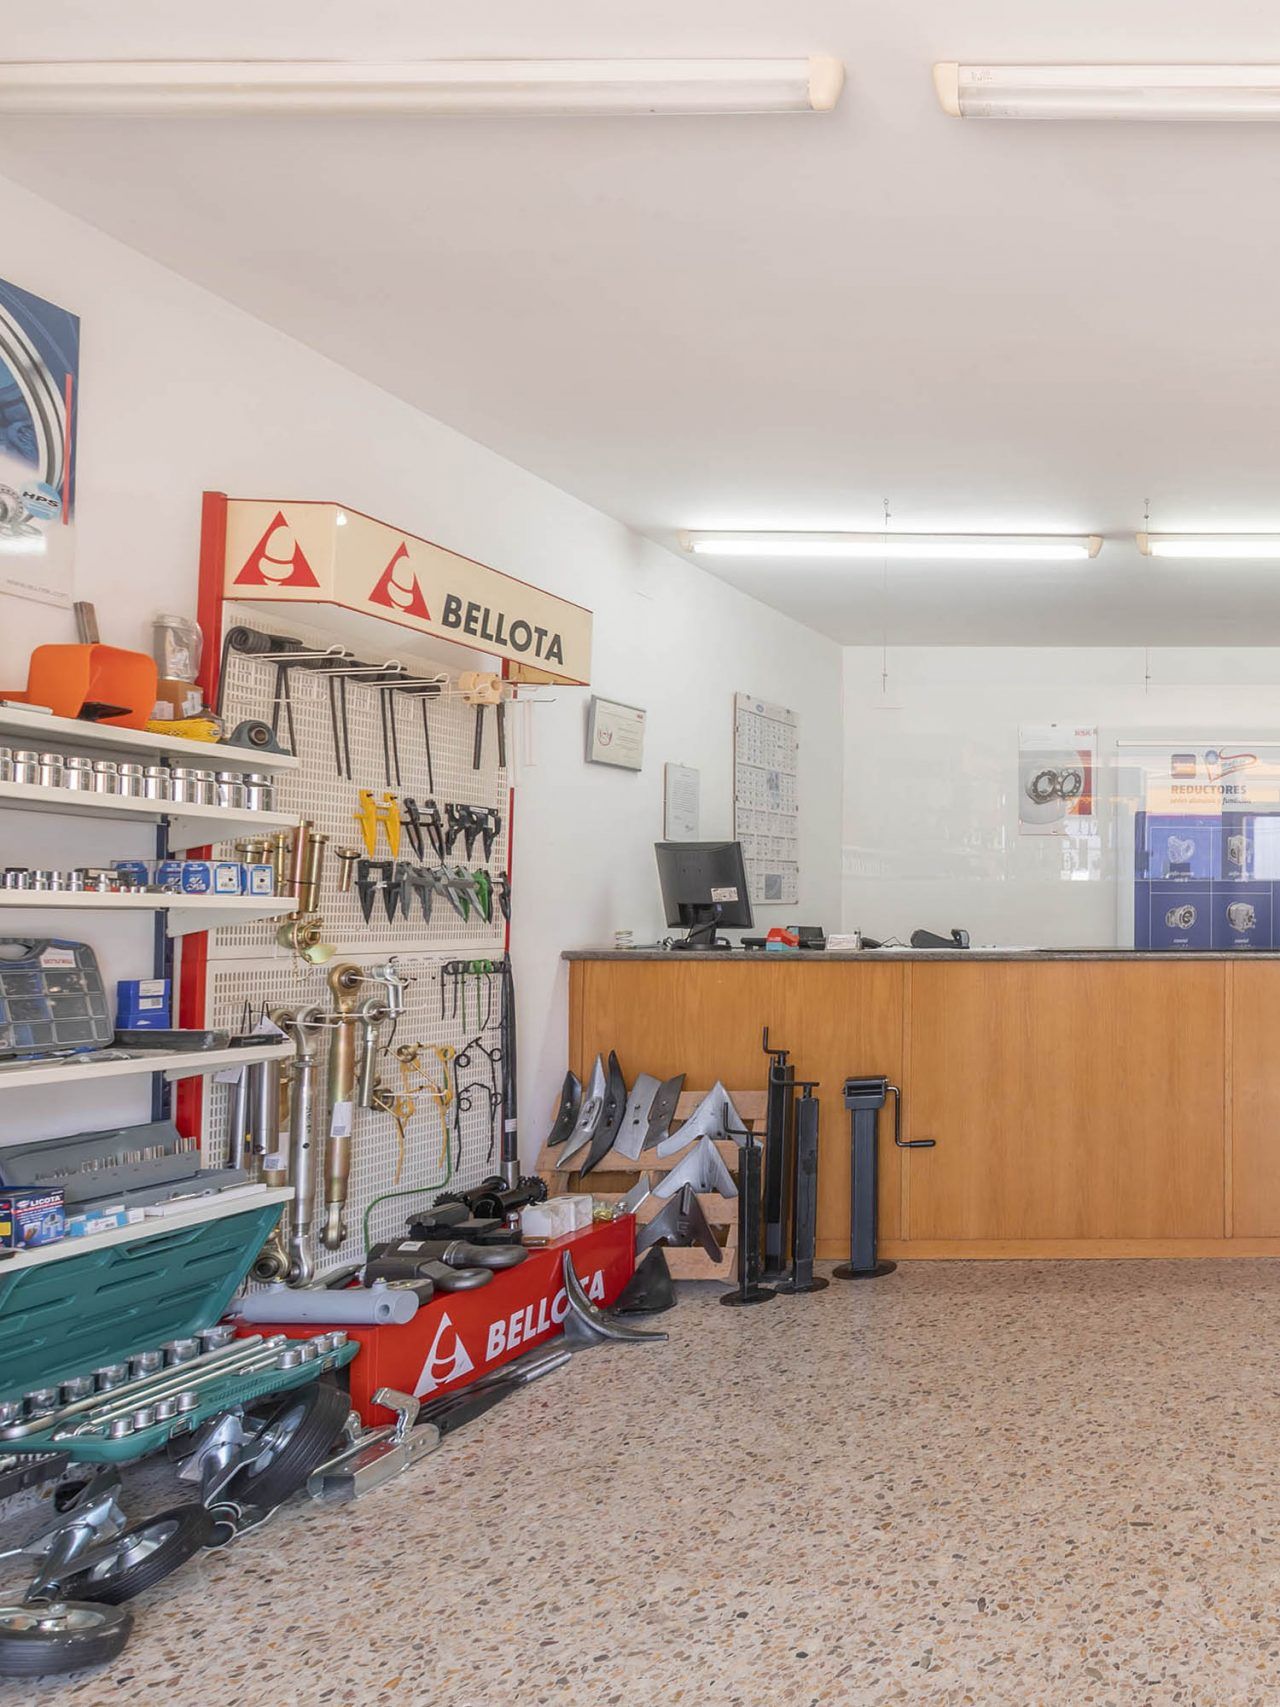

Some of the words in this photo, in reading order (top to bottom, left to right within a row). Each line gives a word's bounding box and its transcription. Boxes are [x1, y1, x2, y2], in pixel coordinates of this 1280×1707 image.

[22, 491, 59, 507] HPS
[441, 593, 564, 665] BELLOTA
[1171, 784, 1247, 795] REDUCTORES
[30, 1195, 61, 1206] LICOTA
